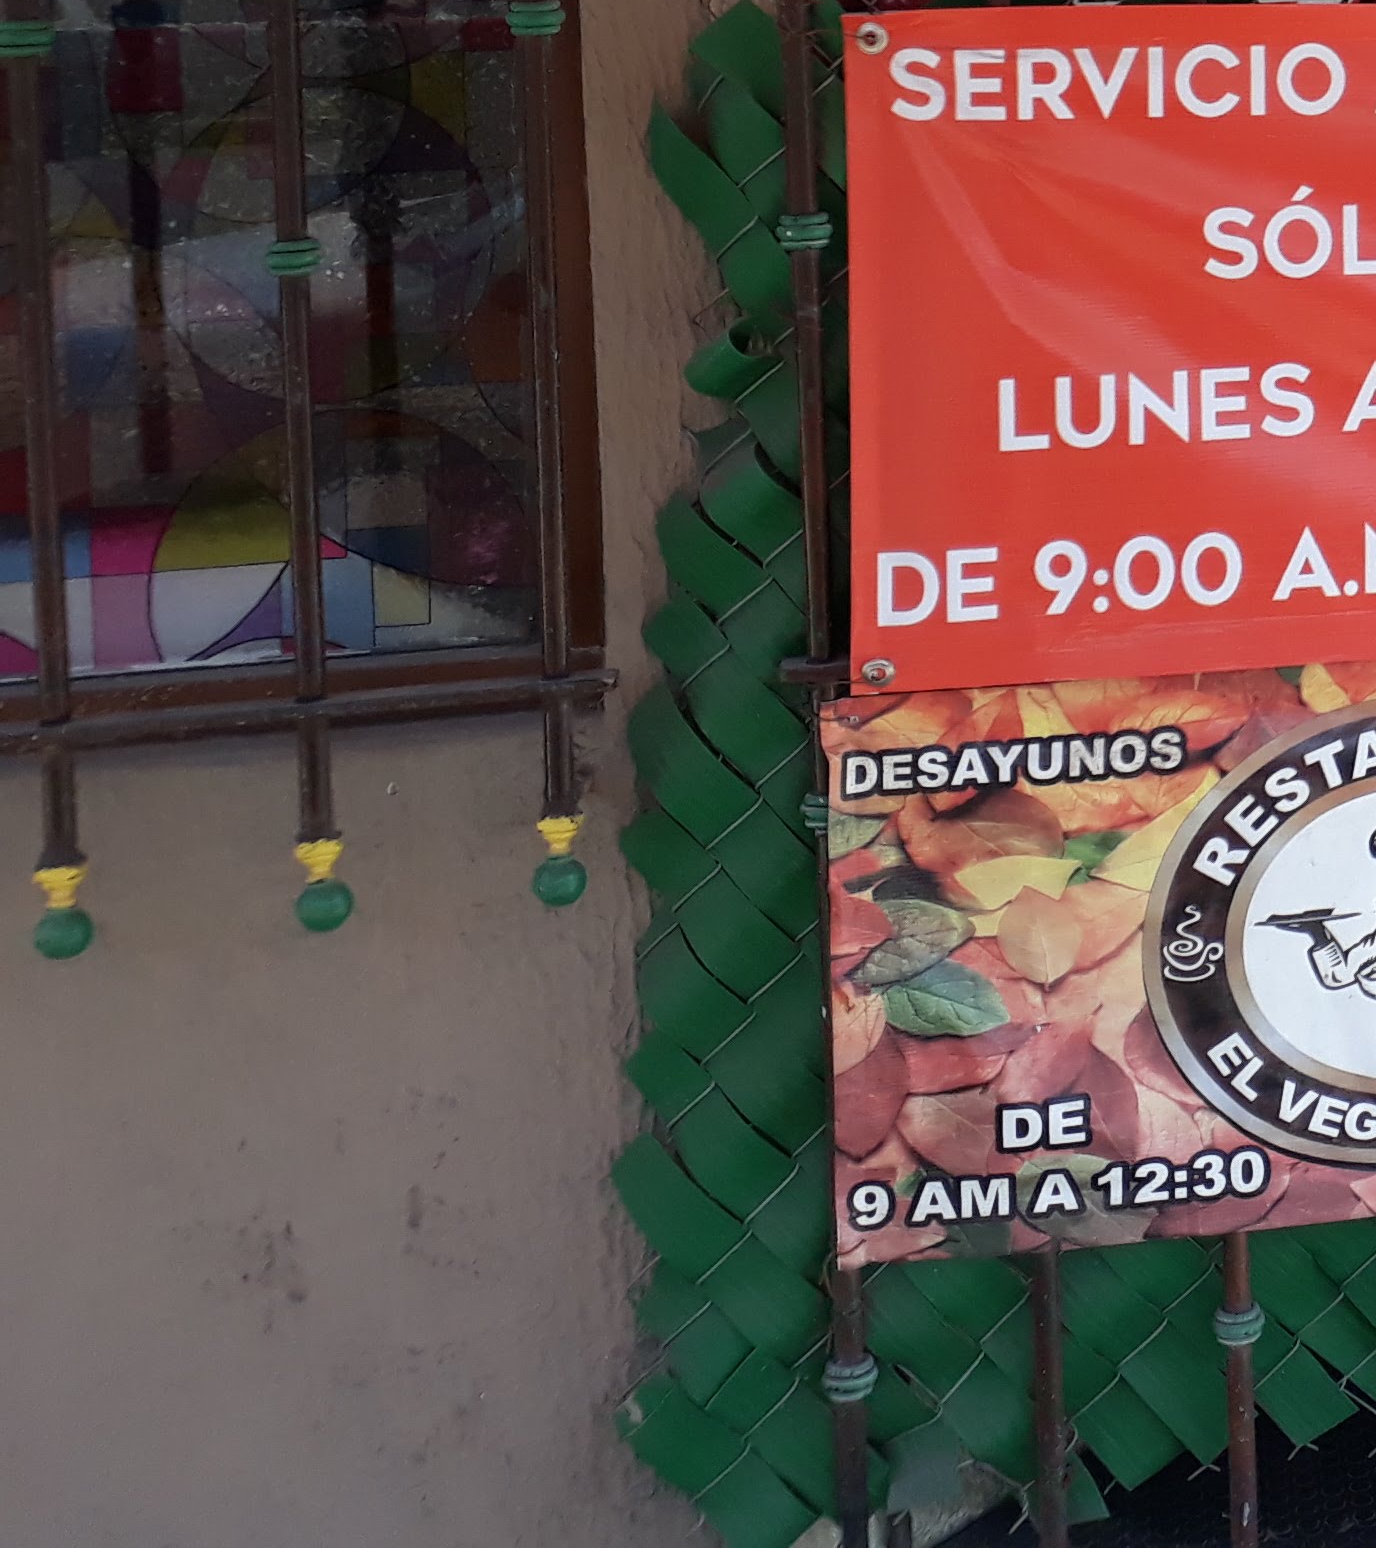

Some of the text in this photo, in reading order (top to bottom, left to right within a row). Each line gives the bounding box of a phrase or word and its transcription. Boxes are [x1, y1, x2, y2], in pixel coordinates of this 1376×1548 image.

[889, 43, 1347, 121] SERVICIO
[998, 361, 1316, 453] LUNES
[876, 545, 999, 628] DE
[1033, 530, 1243, 616] 9:00
[845, 730, 1185, 796] DESAYUNOS
[1206, 1031, 1266, 1102] EL
[1002, 1099, 1088, 1150] DE
[852, 1150, 1267, 1227] 9 AM A 12:30
